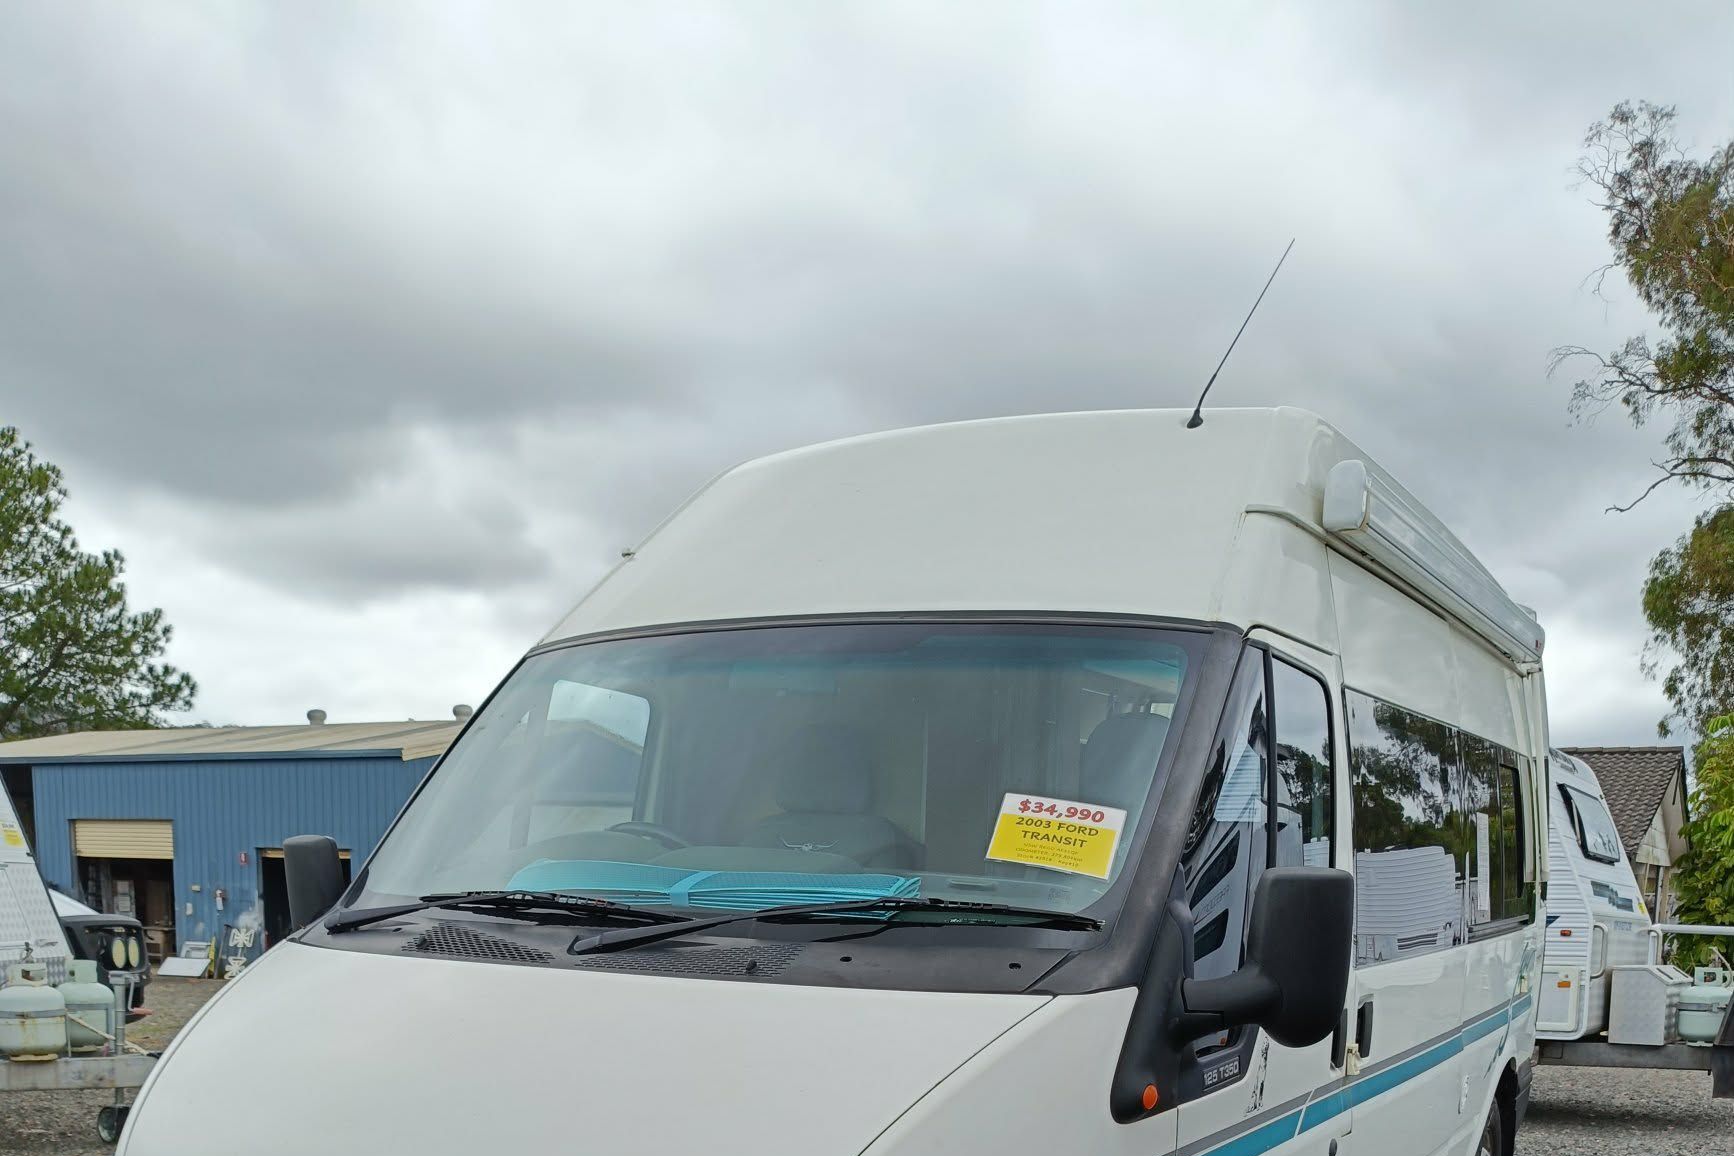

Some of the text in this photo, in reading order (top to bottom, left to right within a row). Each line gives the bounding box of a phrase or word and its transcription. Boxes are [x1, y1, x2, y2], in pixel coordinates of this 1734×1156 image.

[1018, 799, 1105, 823] $34,990
[1015, 817, 1099, 837] 2003 FORD
[1021, 830, 1088, 848] TRANSIT
[1203, 1060, 1240, 1086] 125 T350
